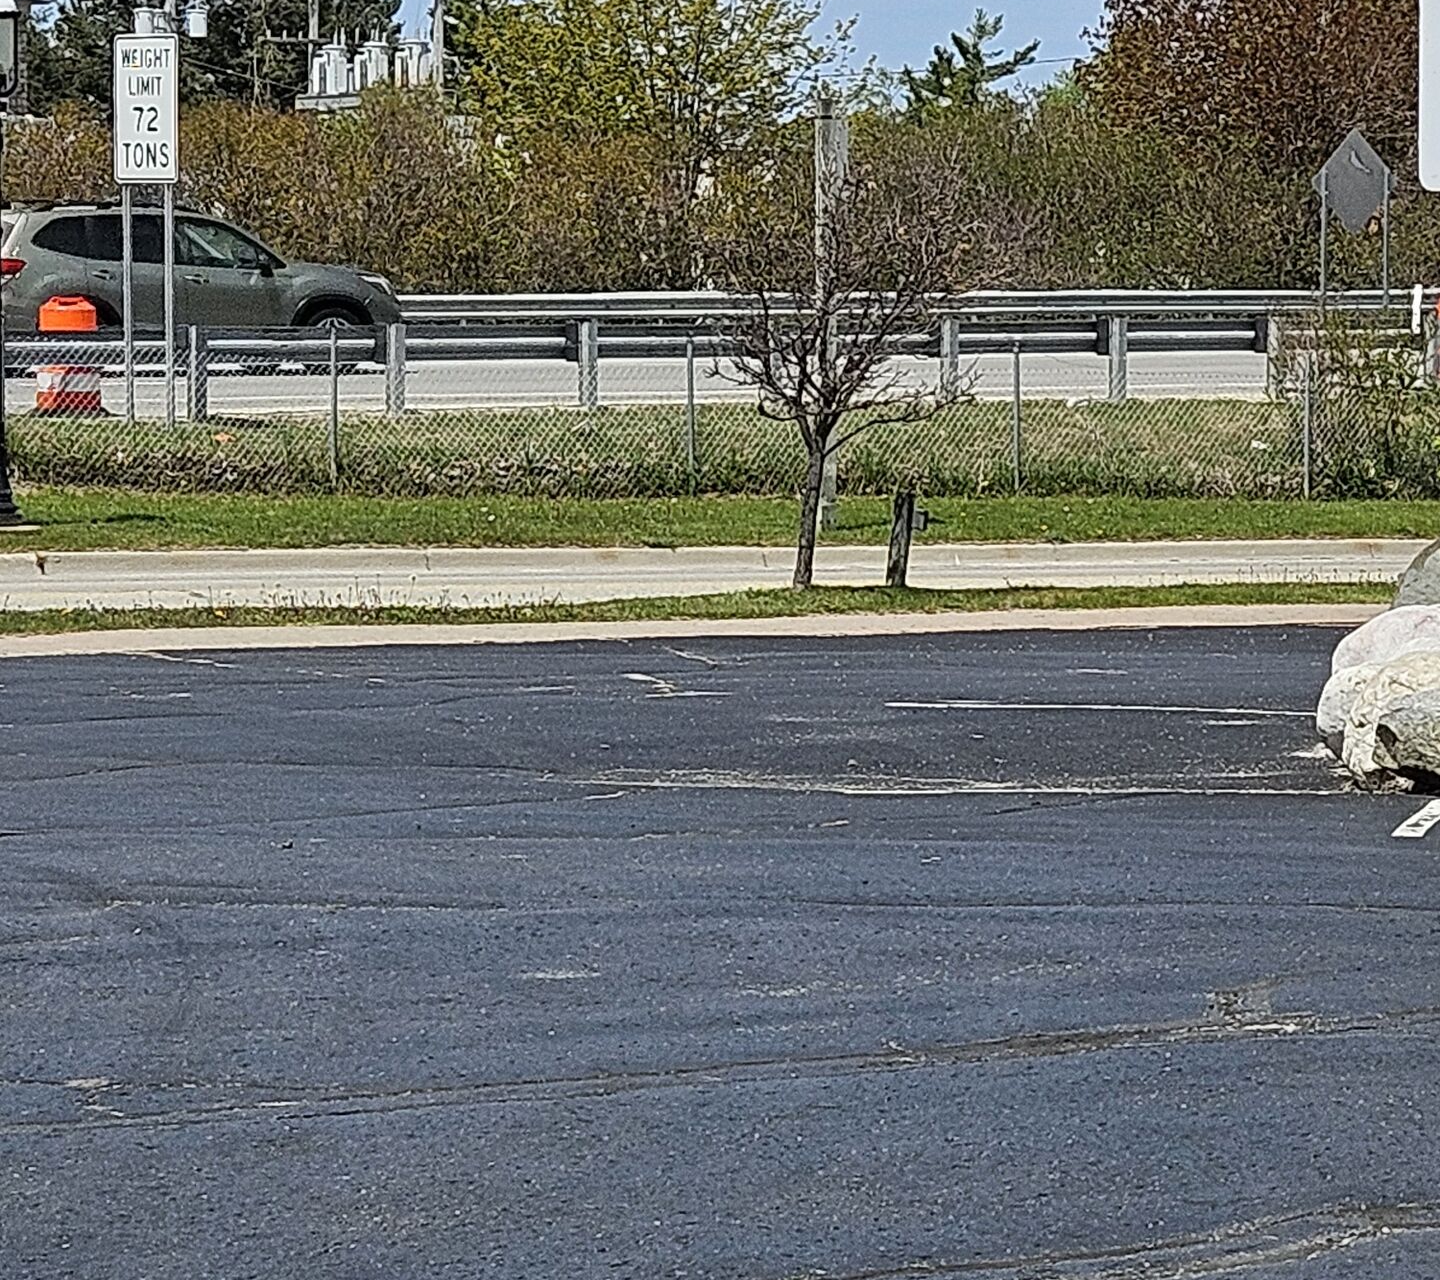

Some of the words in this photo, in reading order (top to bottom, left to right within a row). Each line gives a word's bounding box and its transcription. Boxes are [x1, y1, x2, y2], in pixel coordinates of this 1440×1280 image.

[121, 48, 171, 68] WEIGHT
[128, 76, 162, 96] LIMIT
[132, 106, 159, 132] 72
[122, 142, 170, 168] TONS
